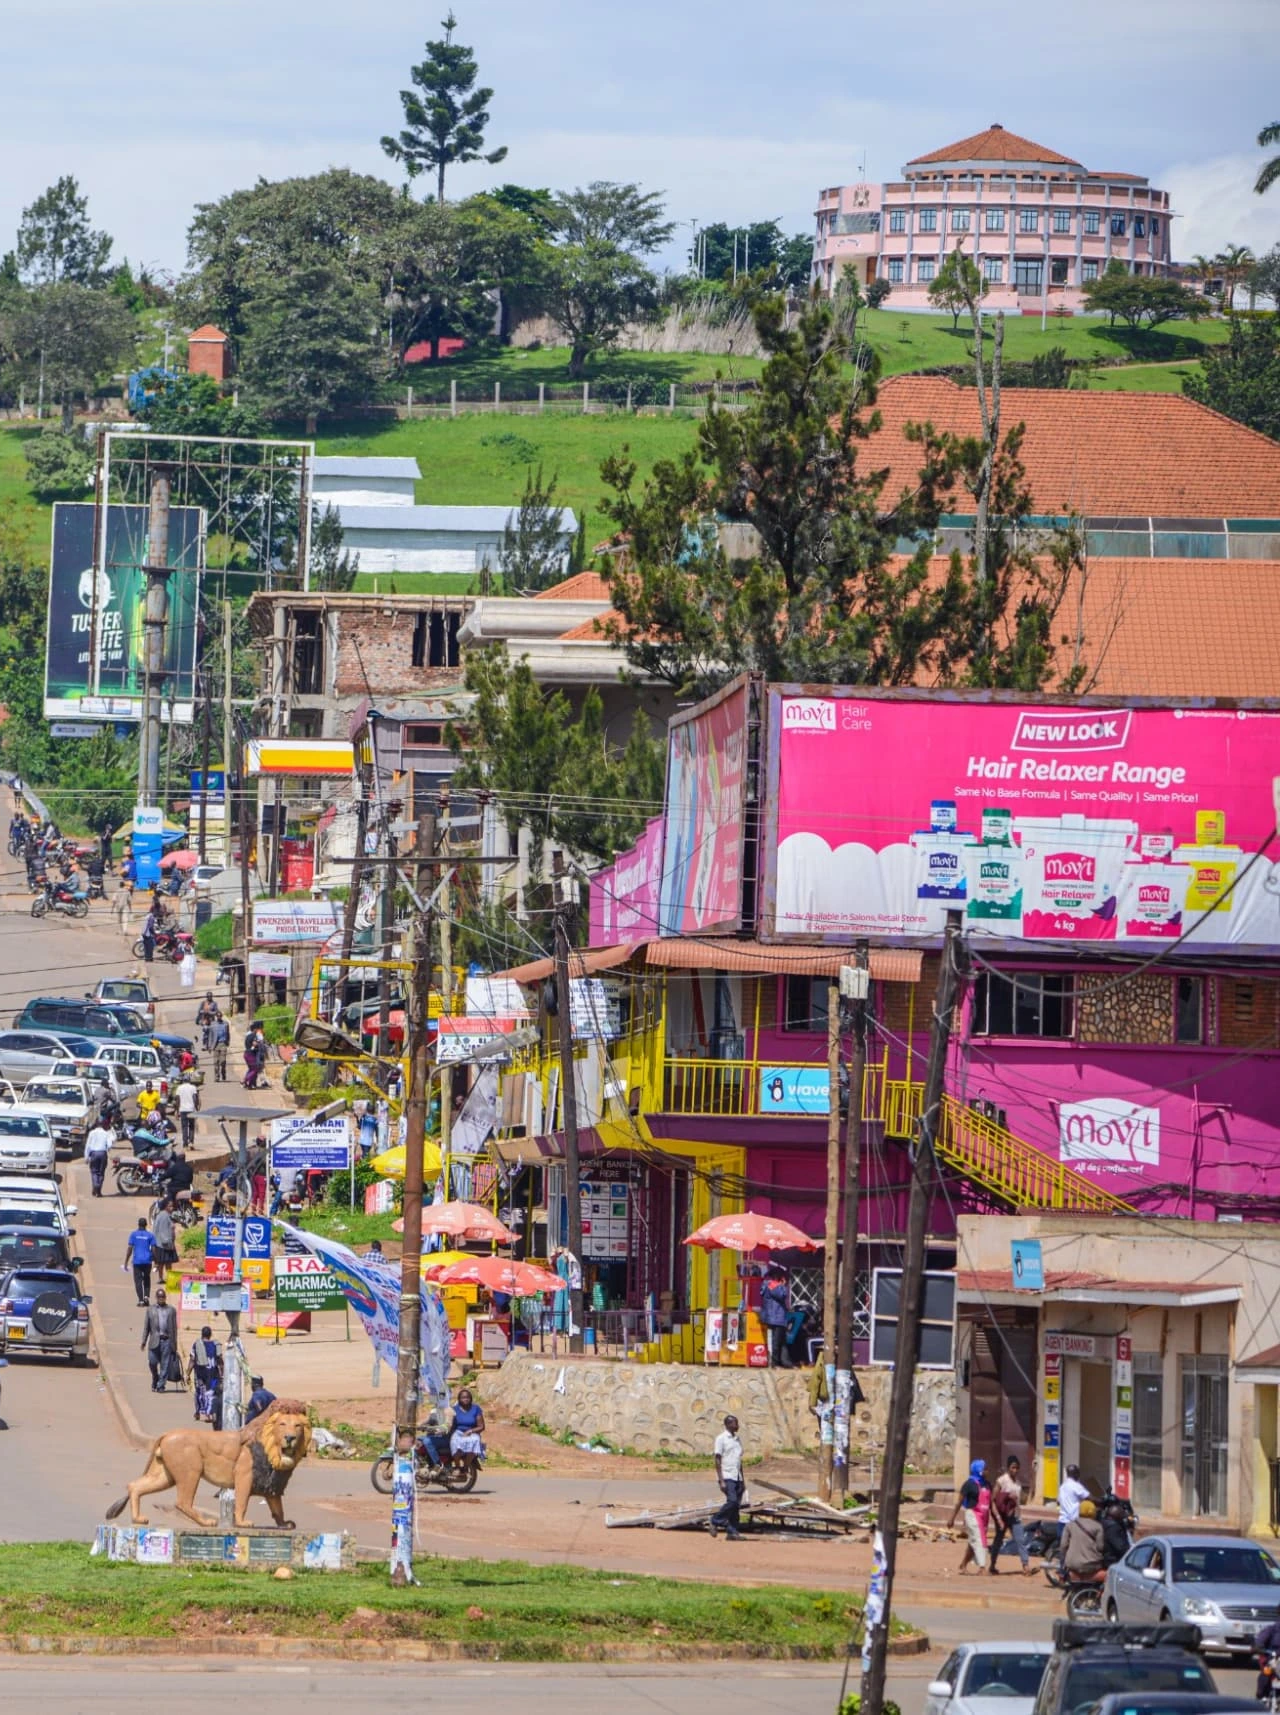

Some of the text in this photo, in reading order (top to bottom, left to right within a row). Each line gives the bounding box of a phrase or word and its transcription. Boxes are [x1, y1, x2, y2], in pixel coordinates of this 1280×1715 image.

[841, 704, 869, 717] Hair
[841, 717, 873, 730] Care
[1022, 720, 1118, 741] NEW LOOK
[967, 755, 1187, 789] Hair Relaxer Range
[954, 786, 1199, 804] Same No Base Formula Same Quality Same Price!
[1041, 889, 1096, 900] Hair Relaxer
[257, 917, 294, 926] RWENZORI
[785, 911, 803, 920] Now
[805, 912, 840, 921] Available
[840, 912, 848, 921] in
[877, 913, 900, 922] Retail
[900, 914, 928, 923] Stores
[275, 925, 321, 934] PRIDE HOTEL
[1062, 920, 1075, 932] kg
[787, 1085, 830, 1096] wave
[599, 1170, 621, 1178] HERE
[277, 1276, 342, 1291] PHARMAC
[37, 1306, 67, 1318] RAV4
[1045, 1335, 1093, 1352] AGENT BANKING
